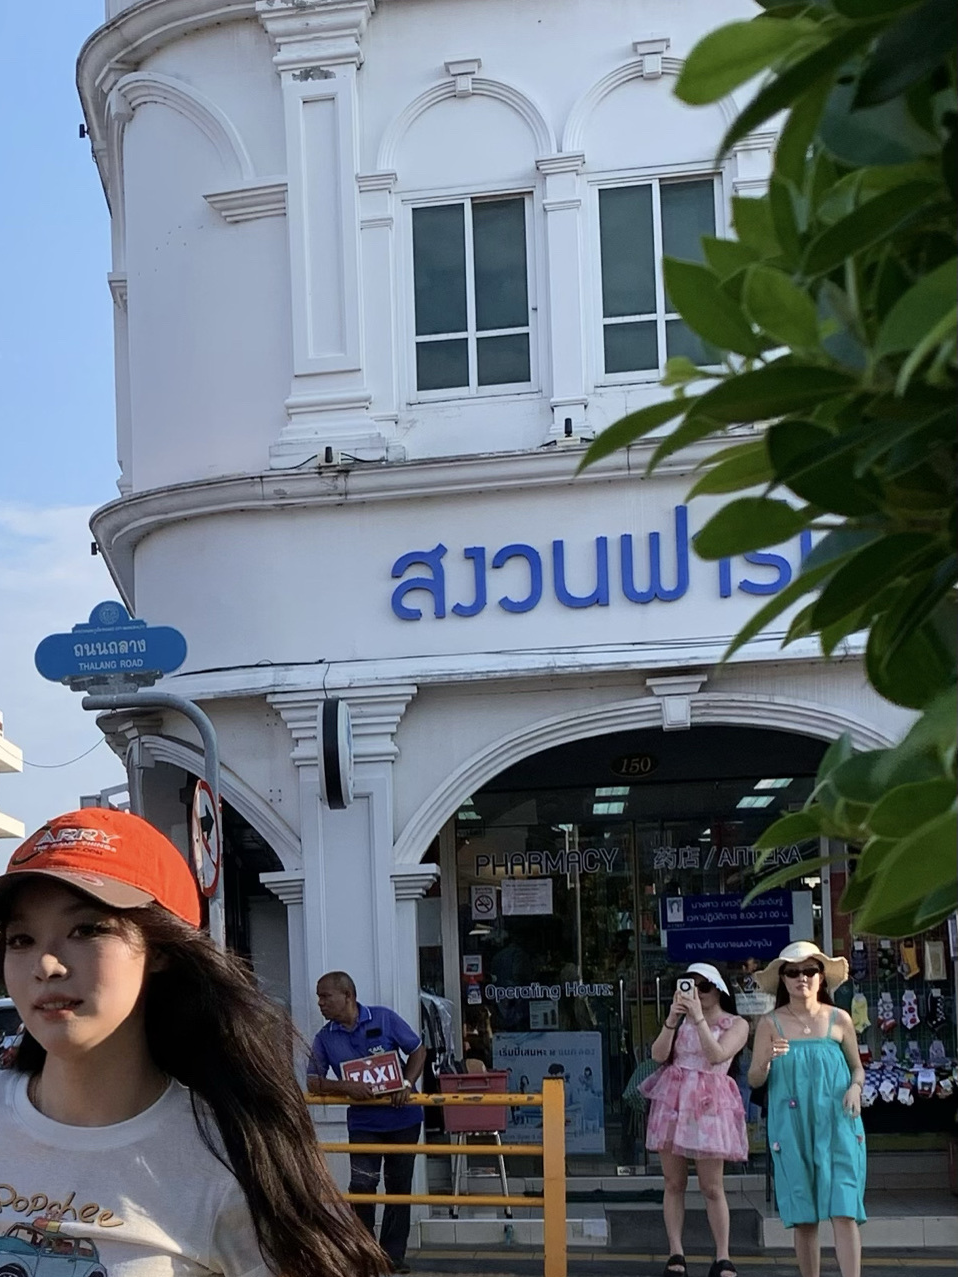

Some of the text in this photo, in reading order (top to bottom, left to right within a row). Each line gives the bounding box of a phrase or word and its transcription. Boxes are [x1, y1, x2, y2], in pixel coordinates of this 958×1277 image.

[73, 638, 147, 657] ถนนถลาง
[78, 658, 144, 671] THALANG ROAD
[620, 757, 651, 773] 150
[475, 848, 619, 876] PHARMACY
[653, 846, 701, 870] 药店
[485, 981, 614, 1002] Operating Hours:
[349, 1064, 396, 1085] TAXI
